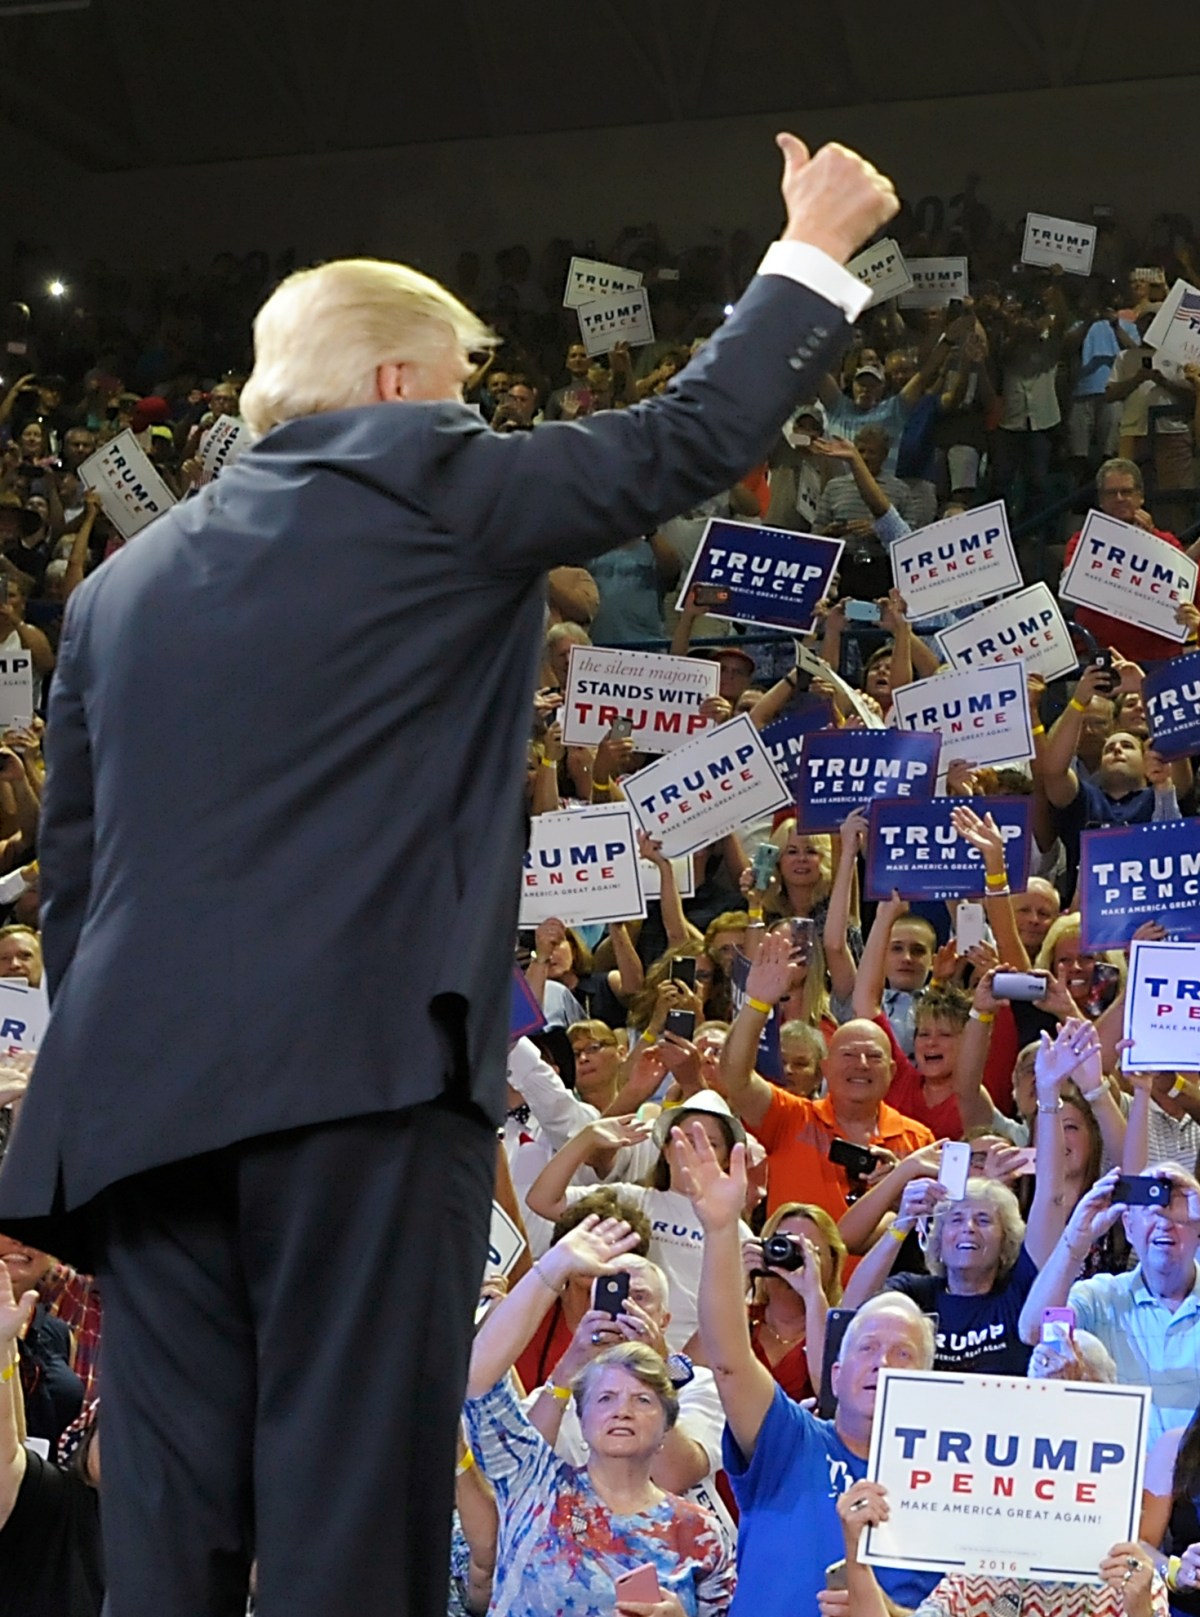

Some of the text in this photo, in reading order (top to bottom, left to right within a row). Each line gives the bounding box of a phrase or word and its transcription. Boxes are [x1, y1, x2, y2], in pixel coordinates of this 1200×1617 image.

[1031, 228, 1090, 248] TRUMP
[1035, 239, 1084, 255] PENCE
[857, 253, 896, 282] UMP
[912, 270, 963, 282] RUMP
[584, 304, 642, 326] TRUMP
[591, 317, 637, 333] PENCE
[101, 457, 144, 516] PENCE
[107, 444, 160, 517] TRUMP
[900, 527, 1001, 574] TRUMP
[709, 548, 823, 582] TRUMP
[911, 548, 995, 584] PENCE
[1090, 538, 1190, 590] TRUMP
[711, 568, 805, 594] PENCE
[1091, 560, 1180, 601] PENCE
[957, 609, 1054, 665] TRUMP
[993, 631, 1054, 664] ENCE
[577, 656, 712, 688] the silent majority
[577, 681, 654, 701] STANDS
[575, 703, 709, 735] TRUMP
[906, 689, 1017, 730] TRUMP
[932, 712, 1007, 734] NCE
[641, 744, 755, 814] TRUMP
[808, 757, 928, 780] TRUMP
[657, 768, 754, 825] PENCE
[814, 781, 912, 796] PENCE
[880, 825, 1022, 845] TRUP
[891, 848, 1007, 860] PENC
[526, 867, 614, 887] ENCE
[886, 864, 910, 872] MAKE
[911, 863, 950, 871] AMERICA
[561, 887, 589, 896] GREAT
[1101, 907, 1126, 916] MAKE
[1128, 903, 1167, 914] AMERICA
[1169, 899, 1197, 910] GREAT
[1150, 1023, 1179, 1032] MAKE
[935, 1323, 1004, 1351] RUMP
[895, 1427, 1126, 1474] TRUMP
[910, 1470, 1098, 1504] PENCE
[901, 1500, 1102, 1525] MAKE AMERICA GREAT AGAIN!
[979, 1559, 1018, 1572] 2016
